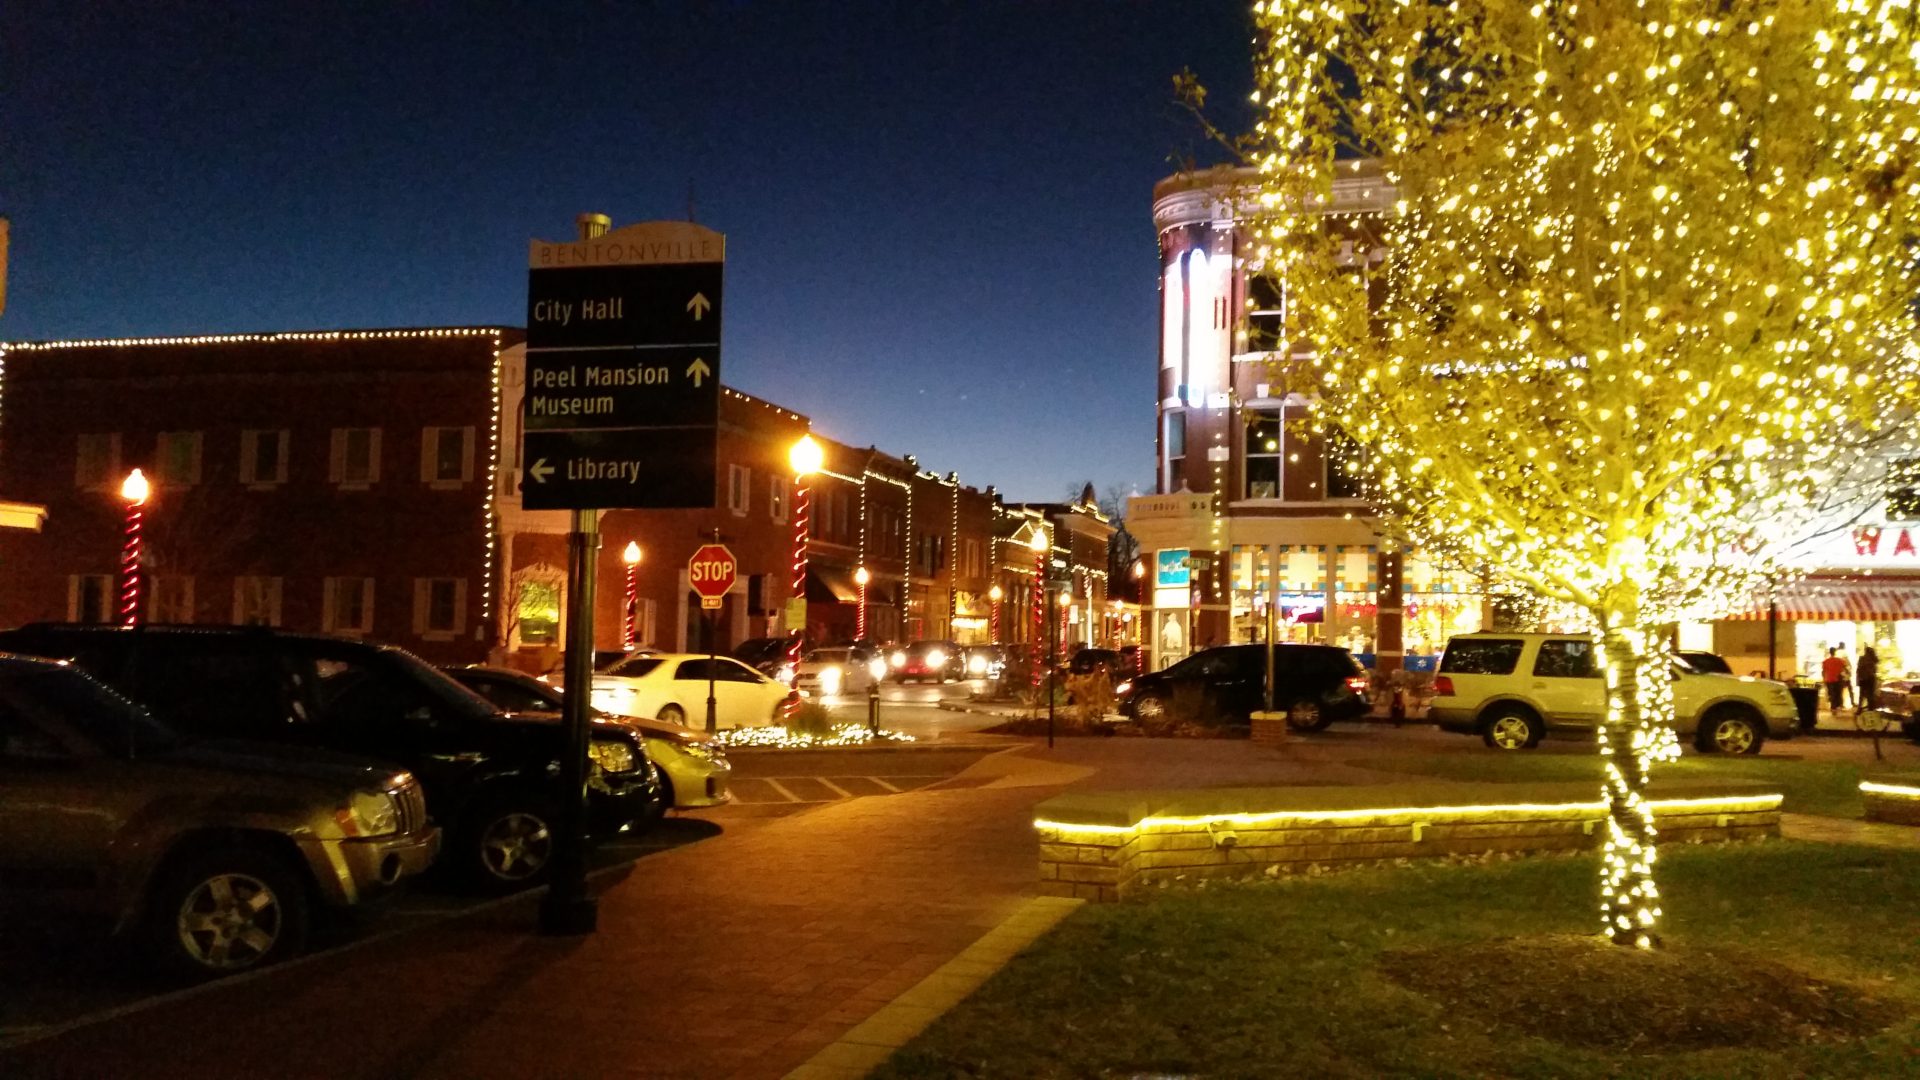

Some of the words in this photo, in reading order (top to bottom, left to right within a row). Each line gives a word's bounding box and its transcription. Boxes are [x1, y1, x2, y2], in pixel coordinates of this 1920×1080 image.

[541, 240, 712, 264] BENTONVILLE
[534, 299, 572, 326] City
[582, 298, 624, 320] Hall
[532, 367, 576, 388] Peel
[585, 363, 669, 387] Mansion
[532, 396, 614, 416] Museum
[568, 459, 641, 484] Library
[691, 561, 733, 582] STOP
